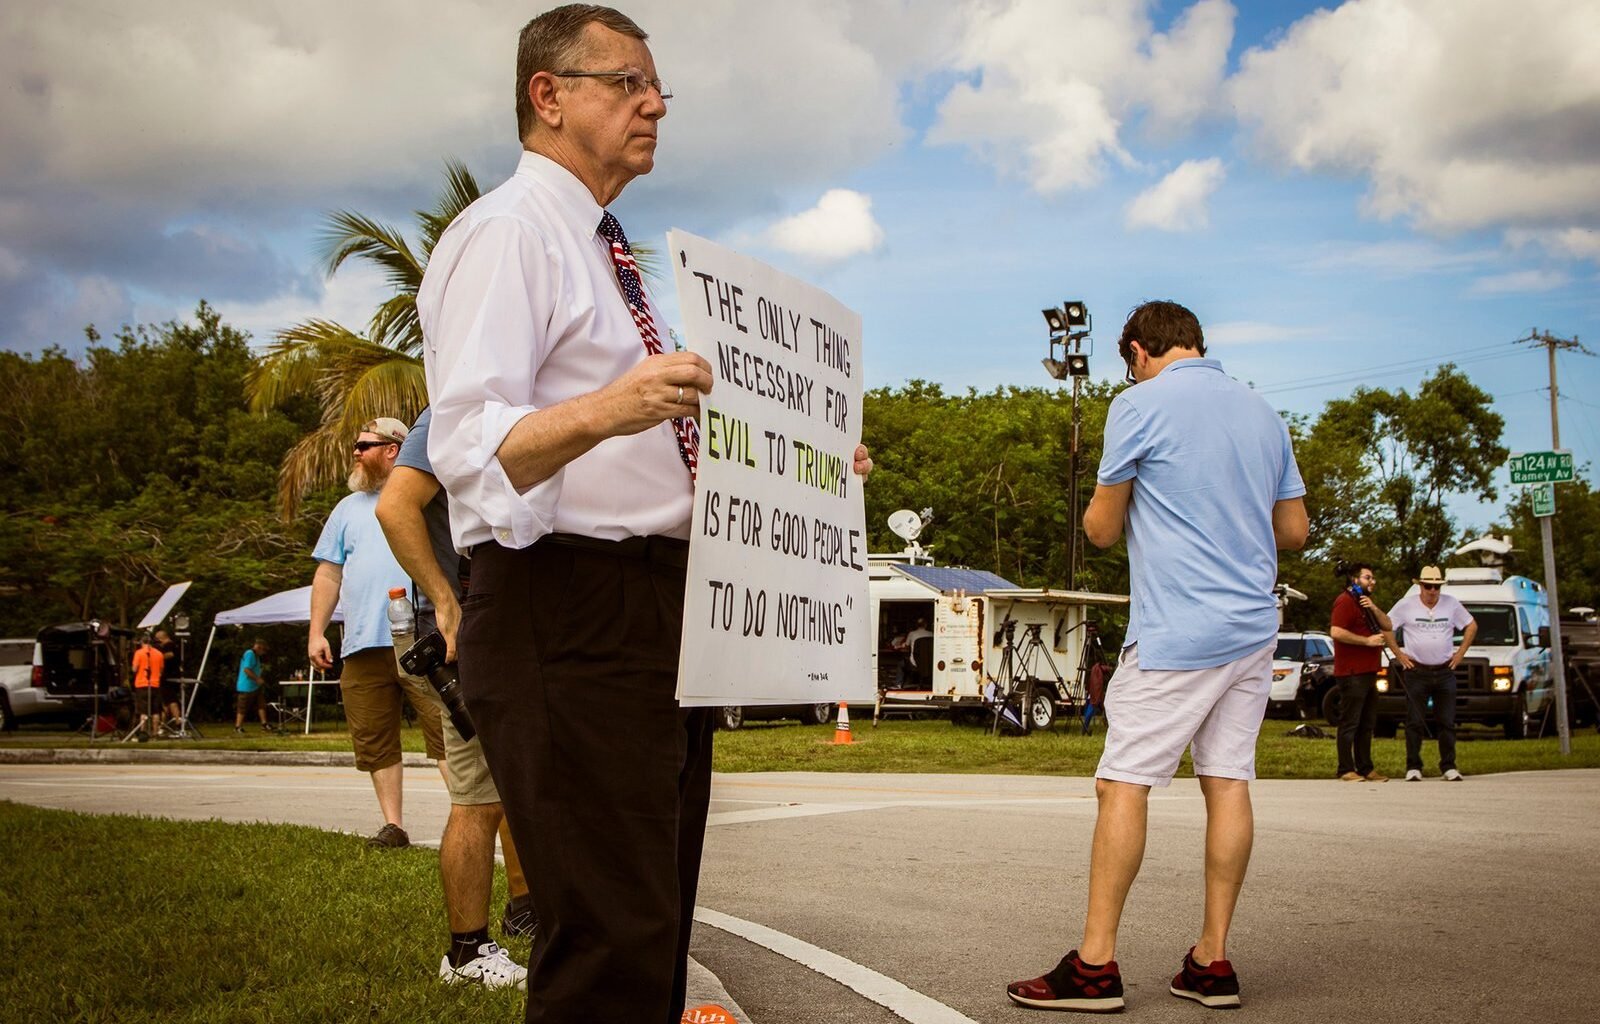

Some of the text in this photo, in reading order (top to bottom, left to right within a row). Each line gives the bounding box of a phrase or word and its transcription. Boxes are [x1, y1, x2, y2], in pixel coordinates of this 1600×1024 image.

[757, 296, 801, 353] ONLY
[810, 317, 851, 379] THING
[717, 341, 848, 434] NECESSARY FOR
[707, 409, 848, 499] EVIL TO TRIUMPH
[1510, 460, 1522, 471] SW
[1523, 455, 1545, 471] 124
[1514, 469, 1569, 482] Ramey Av
[703, 490, 864, 572] IS FOR GOOD PEOPLE
[708, 580, 734, 631] TO
[743, 587, 767, 637] DO
